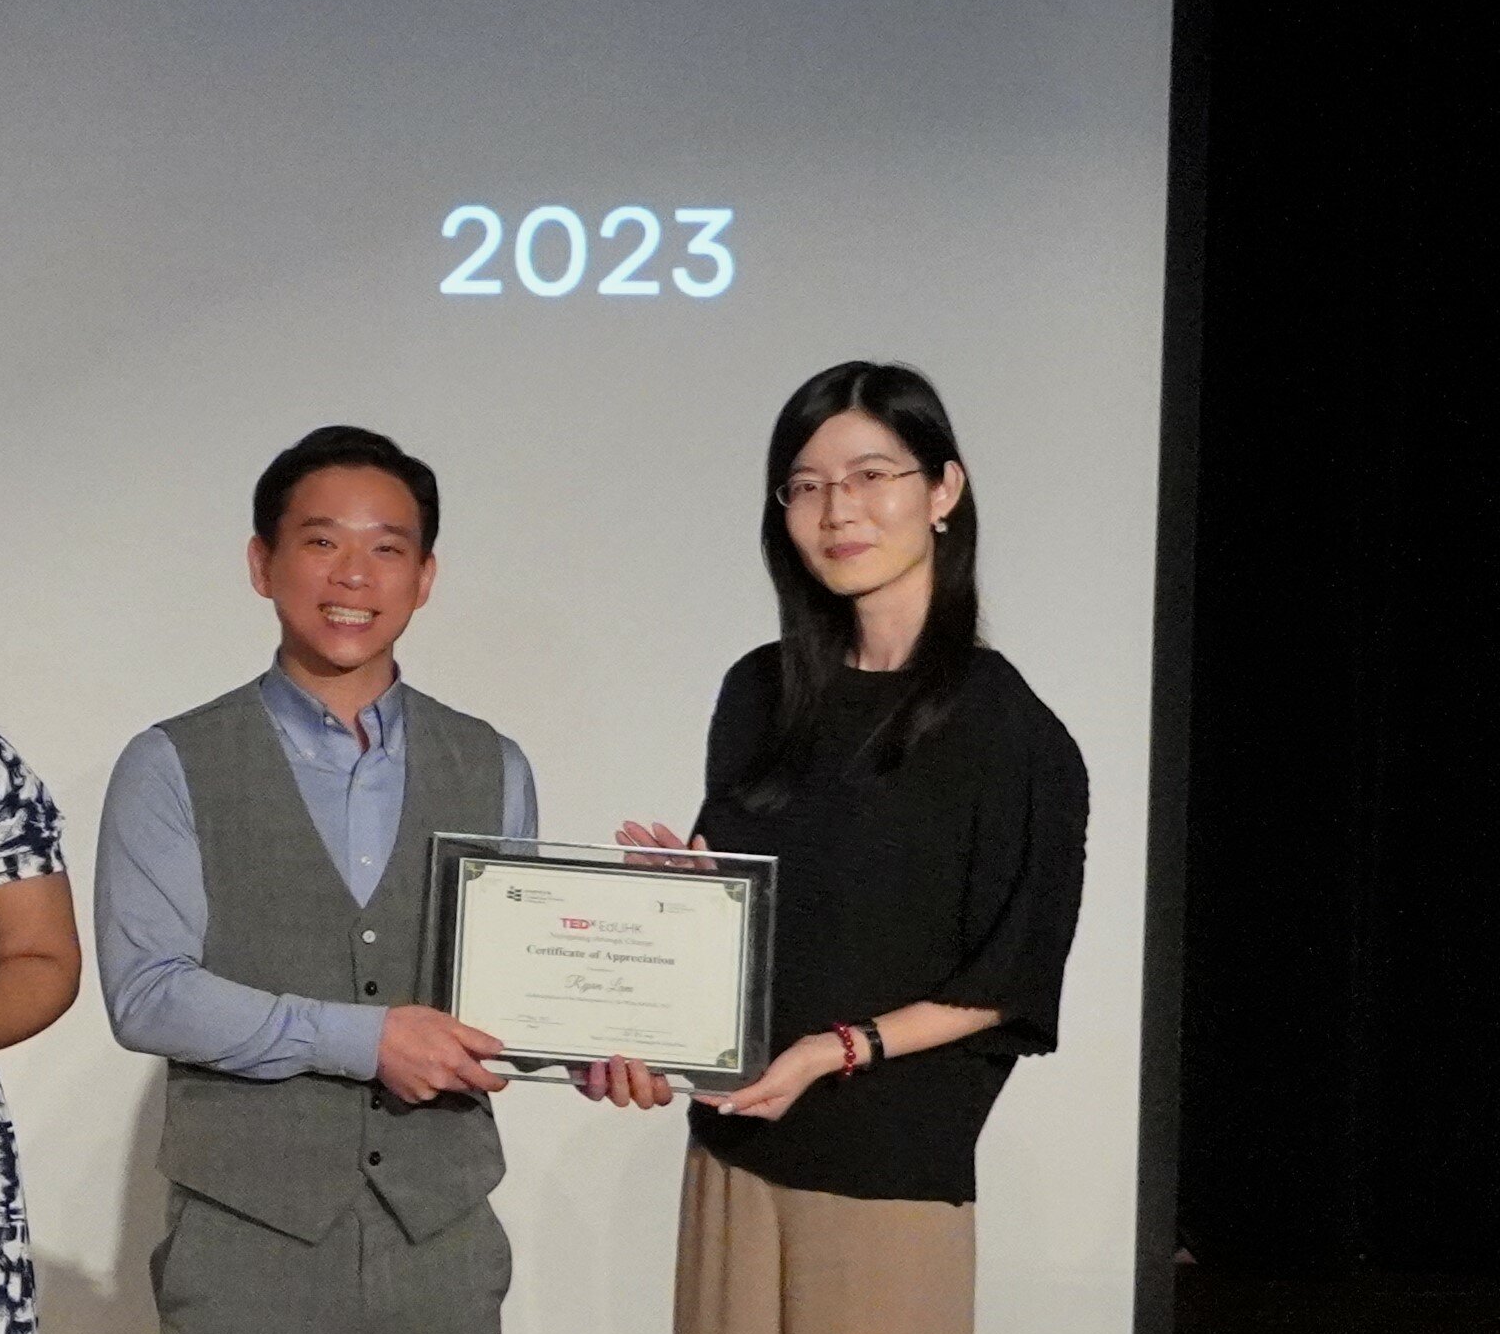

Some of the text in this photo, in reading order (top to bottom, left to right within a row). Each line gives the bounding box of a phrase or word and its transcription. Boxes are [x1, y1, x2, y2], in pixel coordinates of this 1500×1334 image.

[438, 204, 735, 299] 2023
[560, 917, 595, 930] TEDx
[527, 944, 675, 965] Certificate of Appreciation
